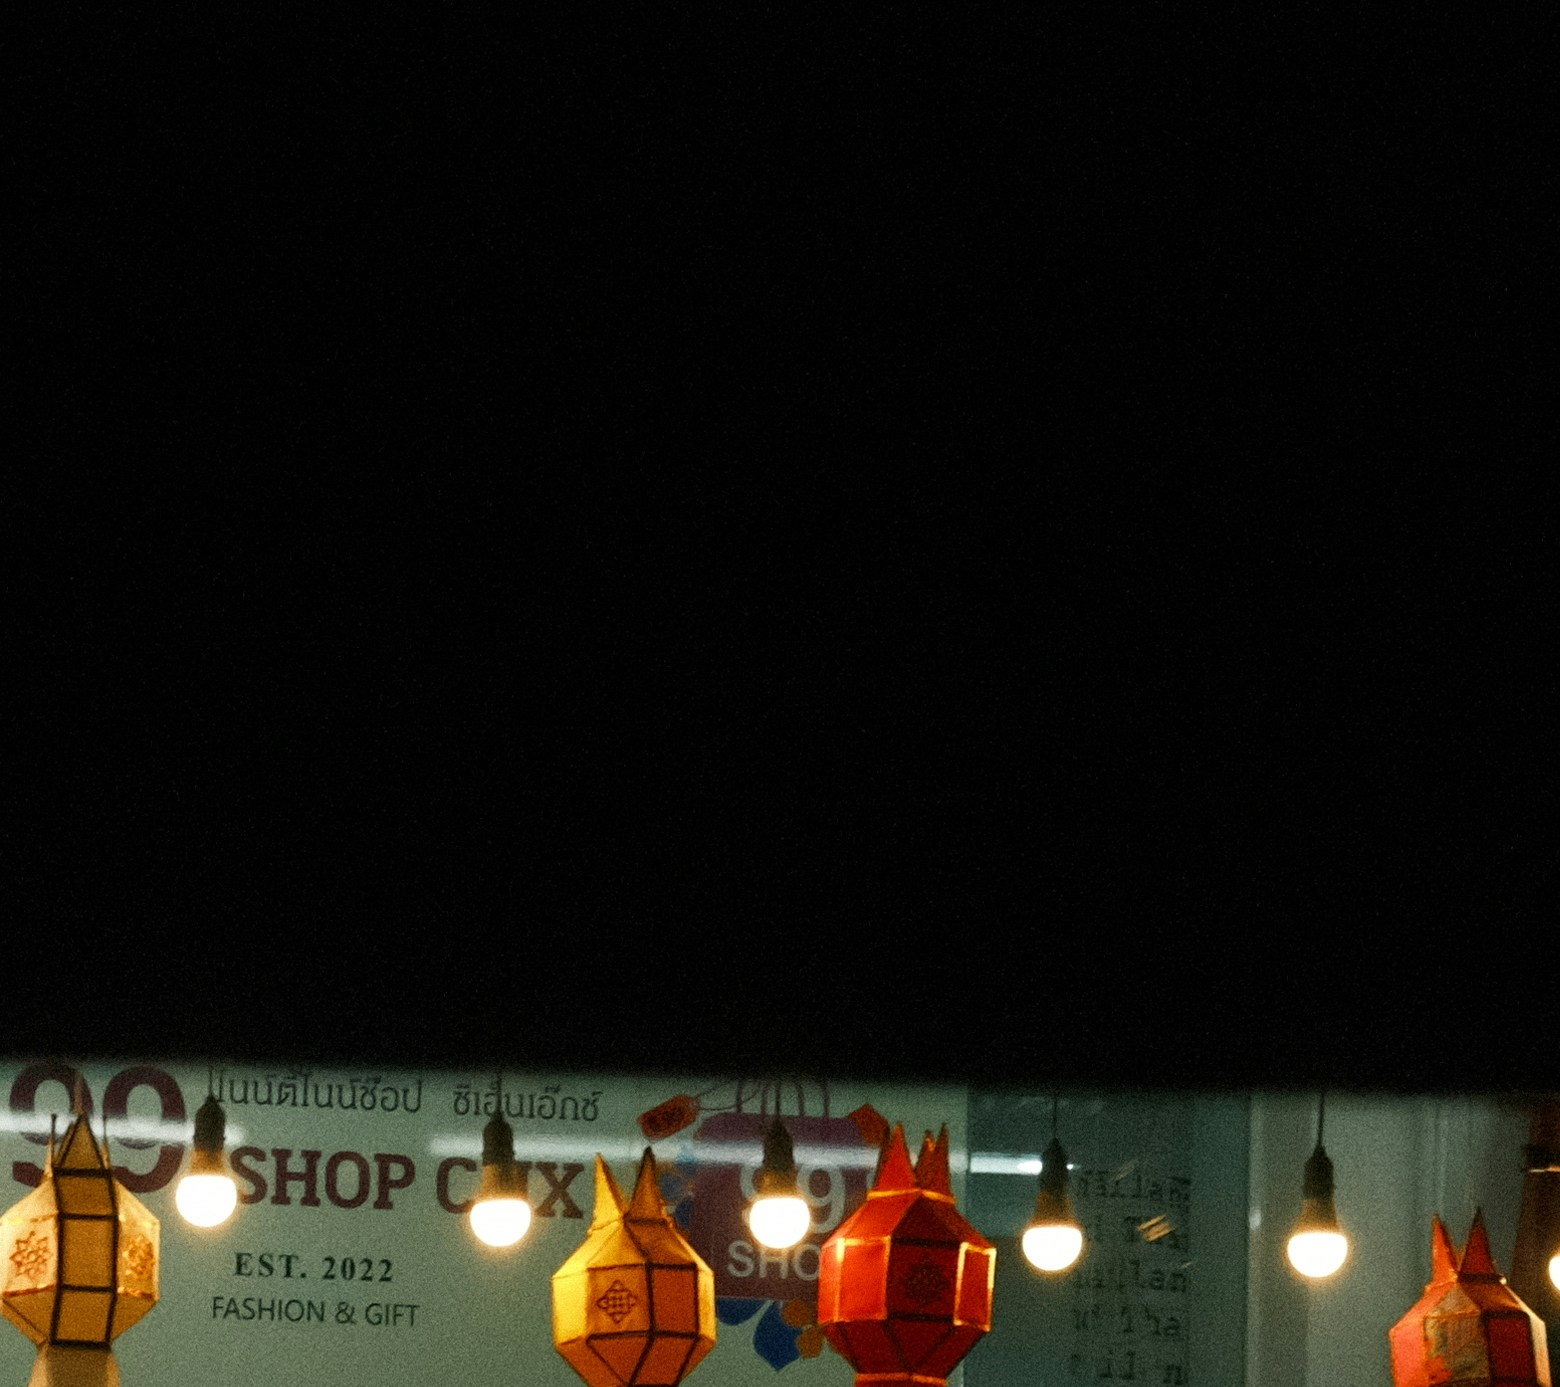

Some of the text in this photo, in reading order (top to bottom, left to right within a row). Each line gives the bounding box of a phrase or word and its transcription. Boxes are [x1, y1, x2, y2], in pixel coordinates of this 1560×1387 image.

[230, 1146, 585, 1219] SHOP CX
[234, 1252, 395, 1283] EST. 2022
[727, 1239, 822, 1282] SHO
[211, 1295, 420, 1328] FASHION & GIFT
